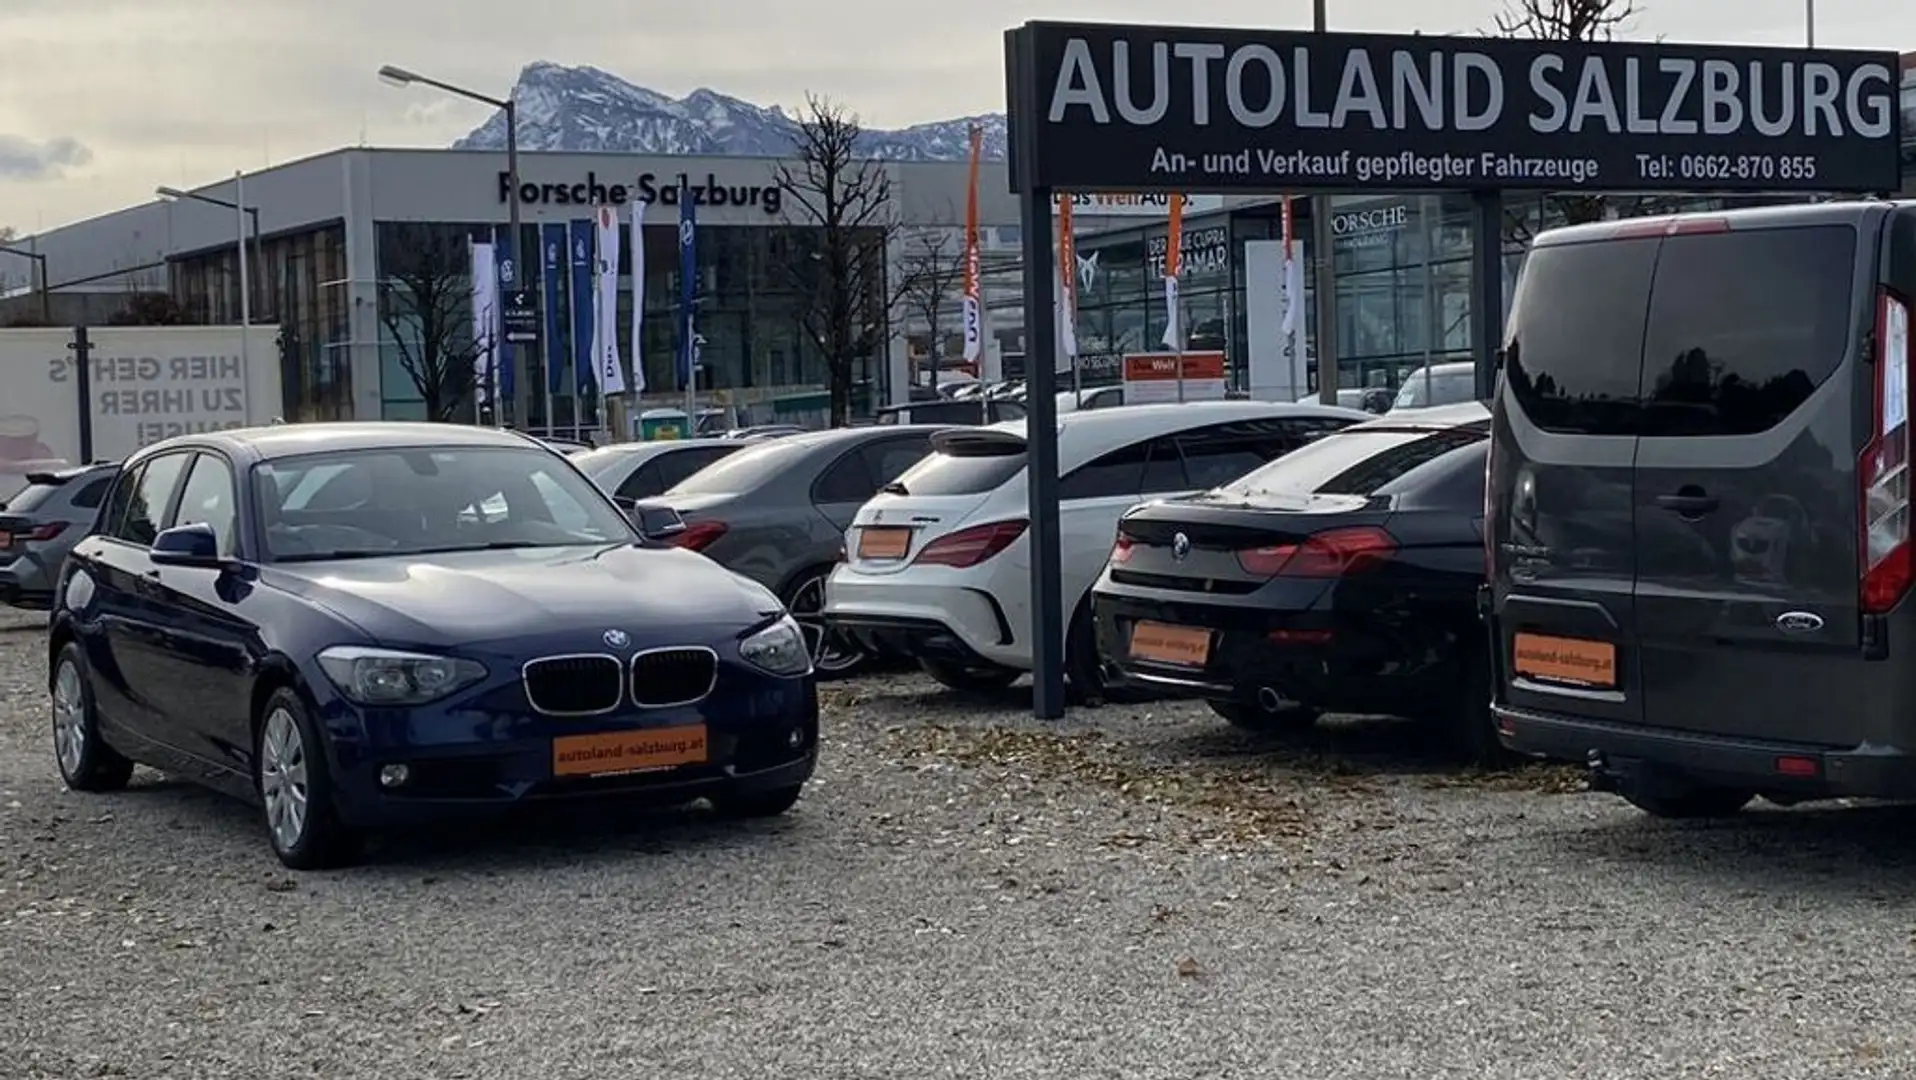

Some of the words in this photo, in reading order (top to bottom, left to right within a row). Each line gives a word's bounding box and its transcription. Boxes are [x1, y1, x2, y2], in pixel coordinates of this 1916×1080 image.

[1048, 38, 1504, 131] AUTOLAND
[1528, 53, 1892, 139] SALZBURG
[1151, 147, 1196, 173] An-
[1204, 149, 1250, 174] und
[1258, 148, 1351, 176] Verkauf
[1355, 151, 1476, 182] gepflegter
[1481, 152, 1599, 183] Fahrzeuge
[1636, 154, 1674, 179] Tel:
[1680, 155, 1774, 180] 0662-870
[1780, 156, 1816, 180] 855
[1330, 205, 1407, 233] ORSCHE
[1149, 246, 1227, 279] TERAMAR
[557, 737, 704, 763] autoland-salzburg.at
